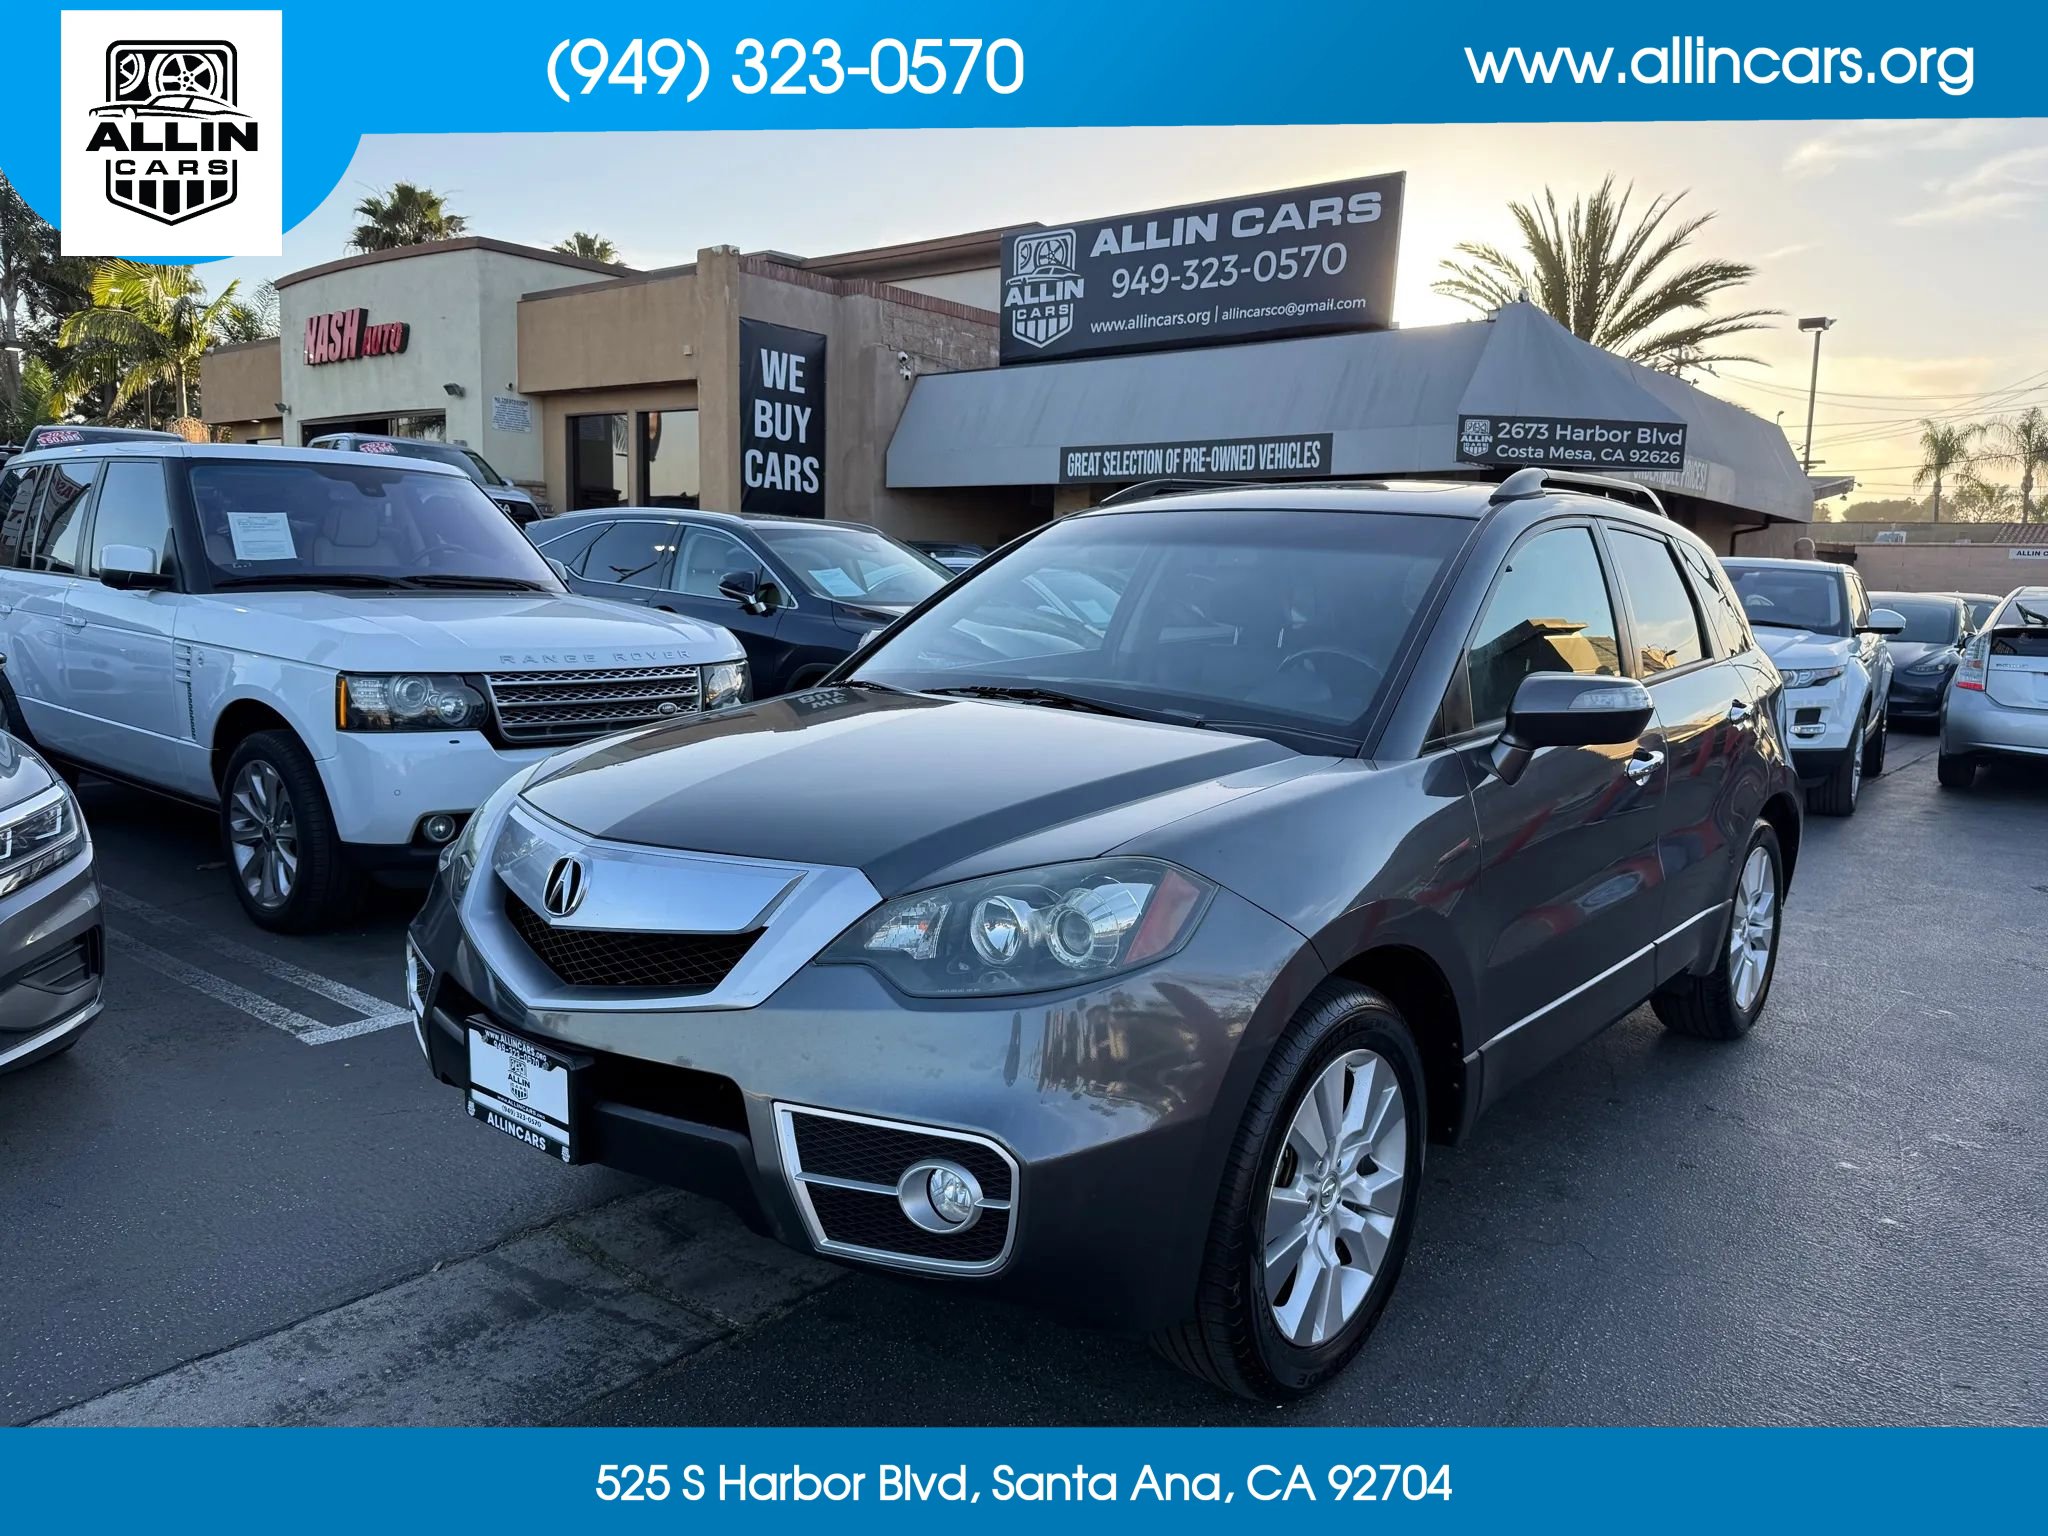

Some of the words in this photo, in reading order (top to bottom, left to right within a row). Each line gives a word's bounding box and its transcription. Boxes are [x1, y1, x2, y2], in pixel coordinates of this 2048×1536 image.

[1089, 212, 1218, 257] ALLIN
[1231, 191, 1382, 239] CARS
[1111, 242, 1348, 299] 949-323-0570
[1004, 278, 1085, 308] ALLIN
[1016, 303, 1069, 320] CARS
[1090, 309, 1211, 333] www.allincars.org
[1221, 298, 1367, 321] allincarsco@gmail.com
[303, 307, 362, 365] NASH
[361, 321, 405, 357] AUTO
[761, 348, 806, 394] WE
[754, 399, 812, 444] BUY
[1498, 422, 1549, 440] 2673
[1556, 424, 1632, 443] Harbor
[1637, 428, 1683, 446] Blvd
[745, 449, 820, 494] CARS
[1067, 452, 1101, 476] GREAT
[1103, 449, 1163, 476] SELECTION
[1166, 447, 1181, 473] OF
[1182, 444, 1256, 473] PRE-OWNED
[1258, 440, 1321, 471] VEHICLES
[1496, 444, 1544, 459] Costa
[1550, 447, 1596, 462] Mesa,
[1600, 448, 1625, 462] CA
[1629, 449, 1681, 464] 92626
[500, 654, 598, 664] RANGE
[613, 649, 691, 662] ROVER
[507, 1073, 531, 1088] ALLIN
[487, 1112, 546, 1151] ALLINCARS
